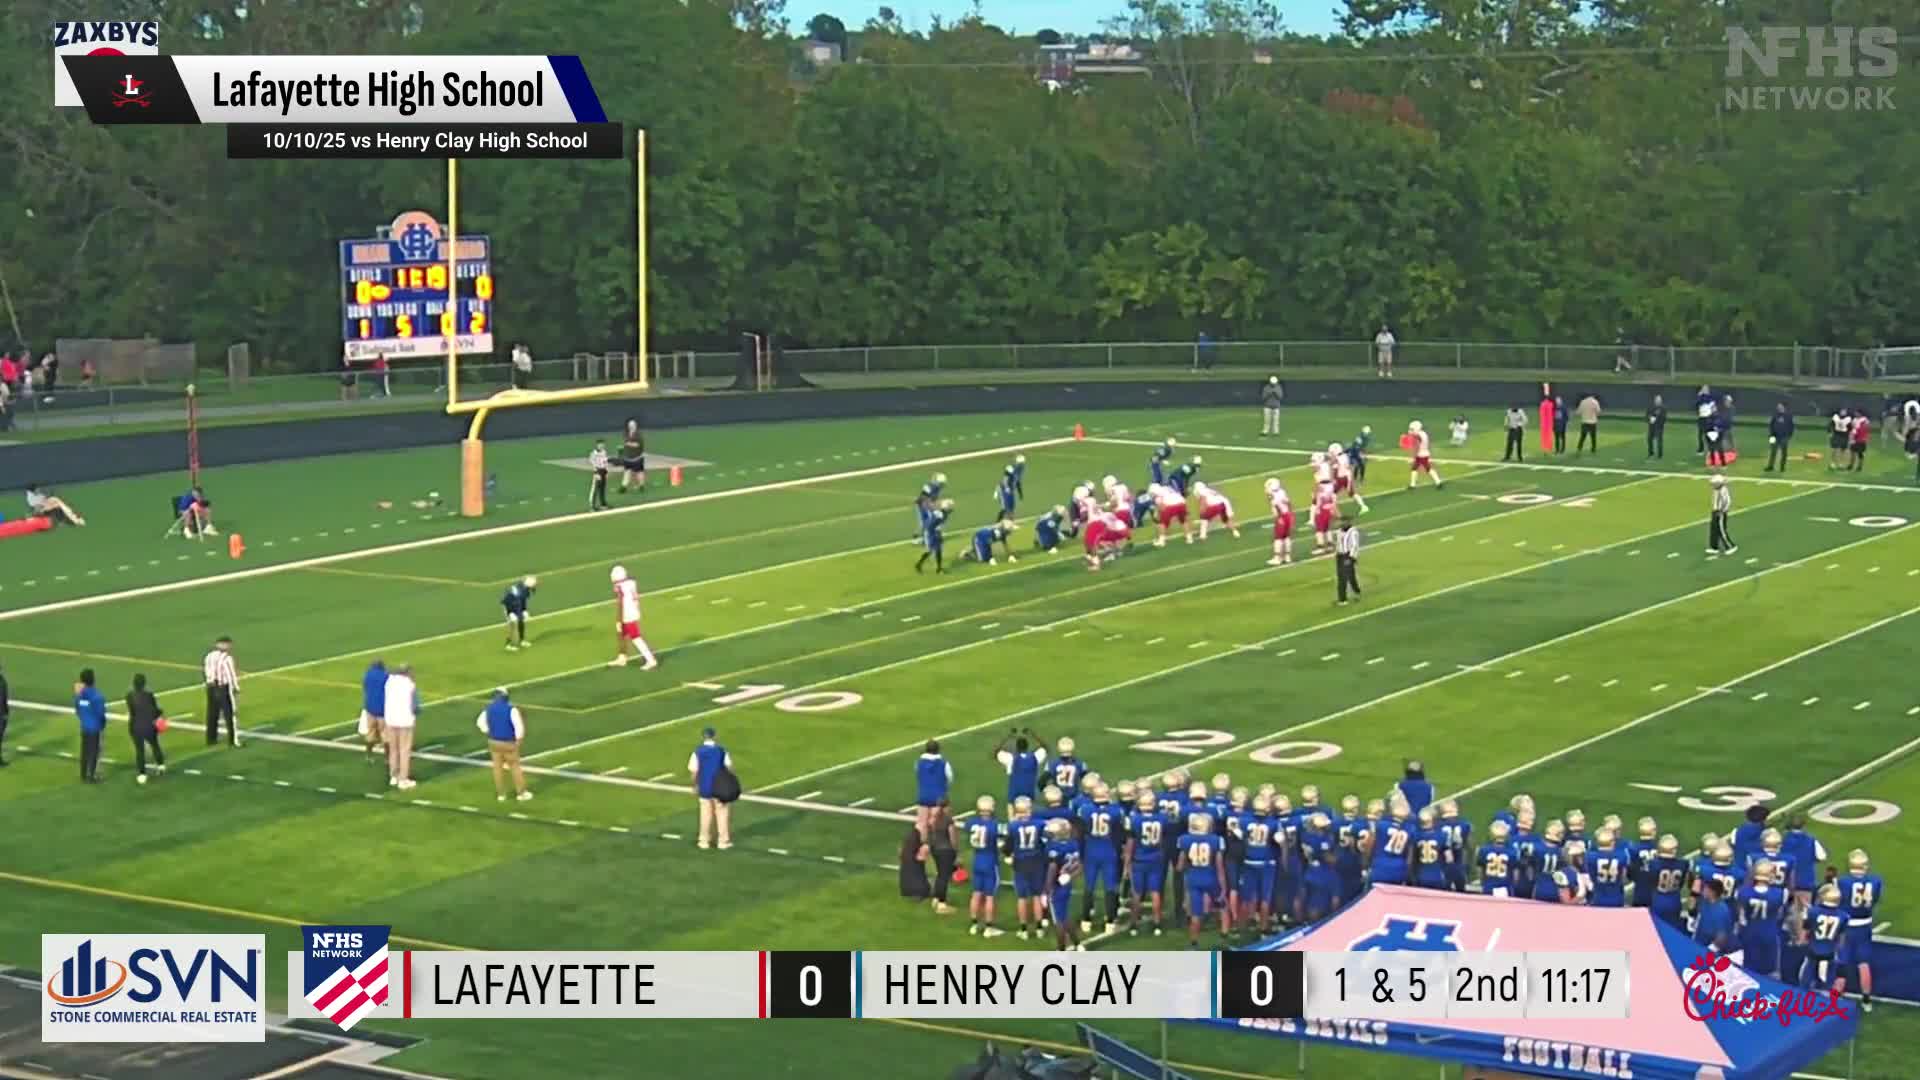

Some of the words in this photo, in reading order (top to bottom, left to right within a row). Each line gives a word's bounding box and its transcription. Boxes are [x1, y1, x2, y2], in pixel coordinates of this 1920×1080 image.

[1018, 824, 1037, 849] 17
[1815, 914, 1840, 940] 37
[1502, 1036, 1633, 1079] FOOTBALL
